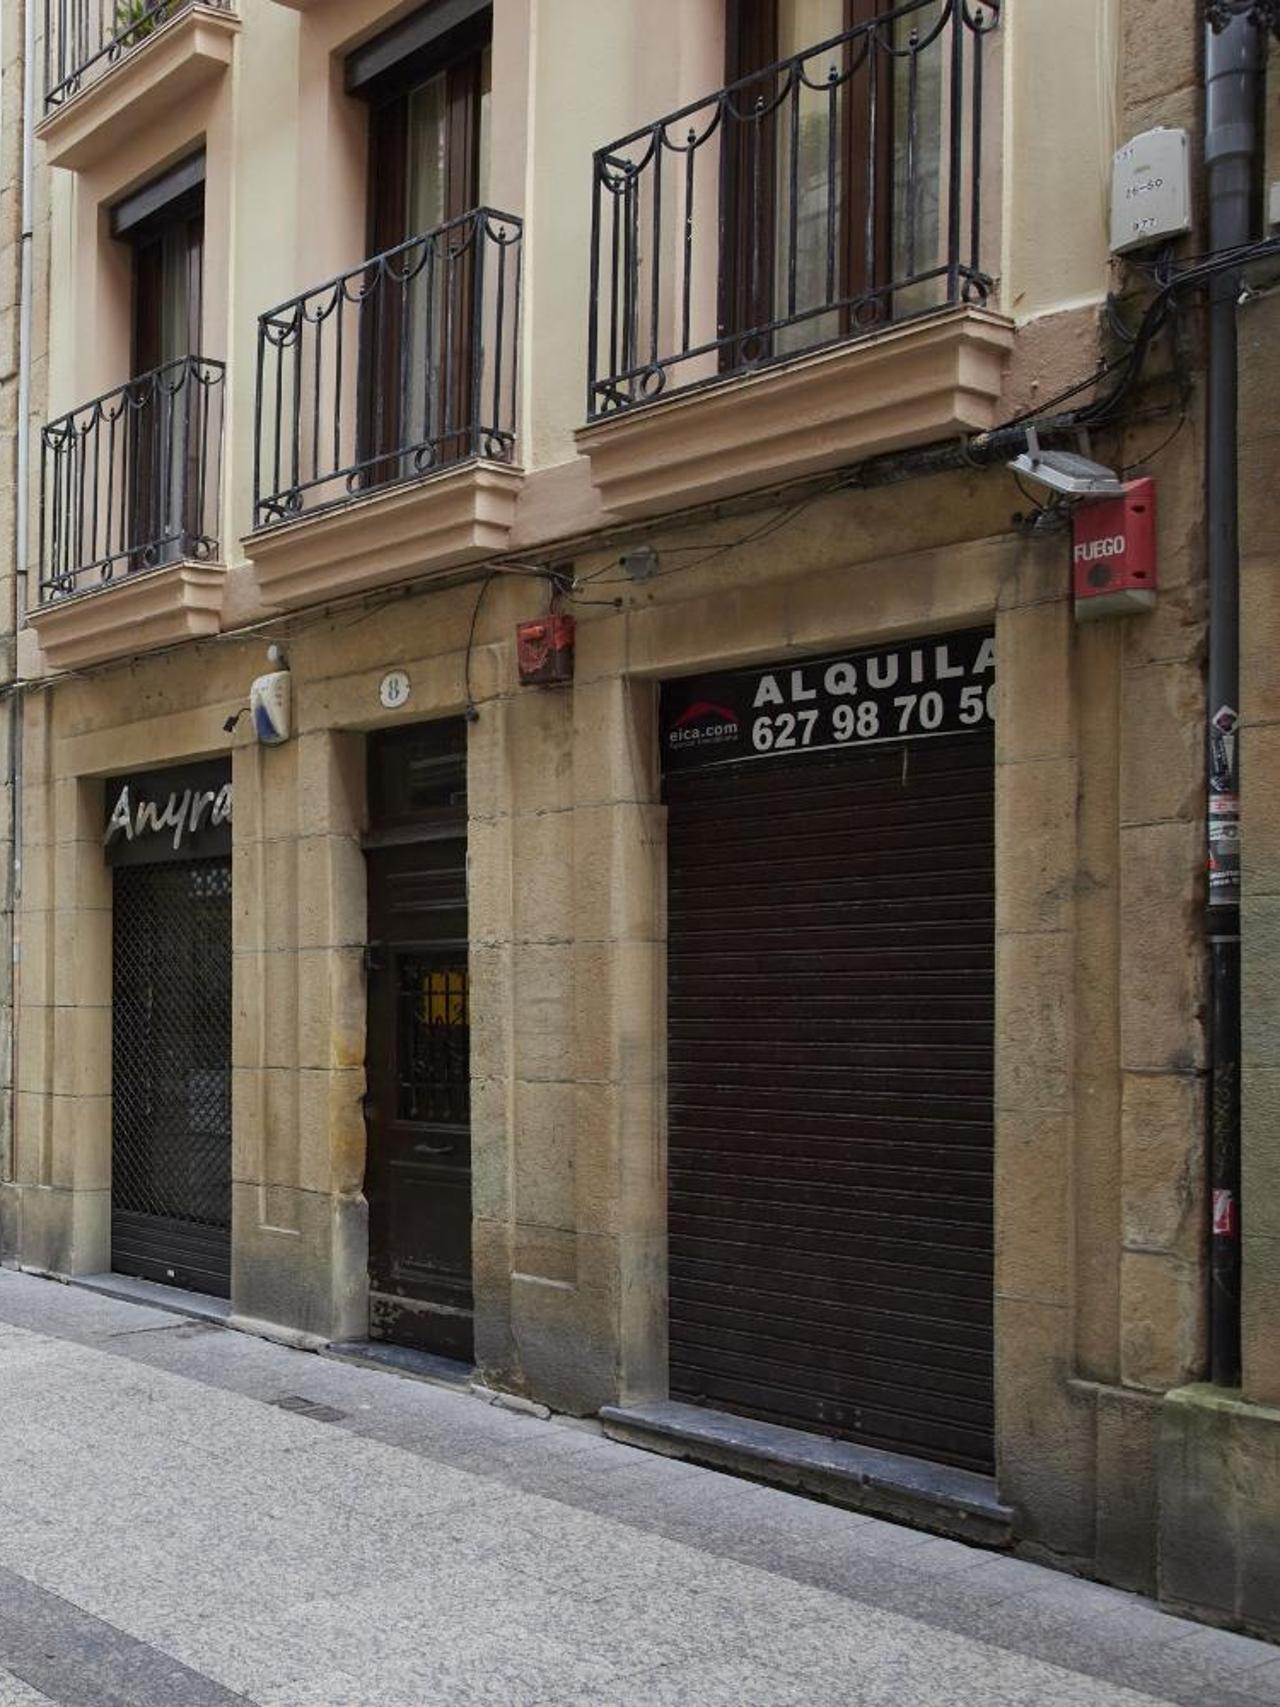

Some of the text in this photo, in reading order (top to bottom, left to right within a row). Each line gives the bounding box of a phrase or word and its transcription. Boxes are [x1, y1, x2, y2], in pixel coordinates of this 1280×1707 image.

[1073, 535, 1125, 563] FUEGO
[752, 638, 996, 708] ALQUILA
[388, 678, 400, 701] 8
[669, 723, 738, 742] eica.com
[752, 709, 819, 751] 627
[831, 701, 879, 741] 98
[893, 690, 944, 731] 70
